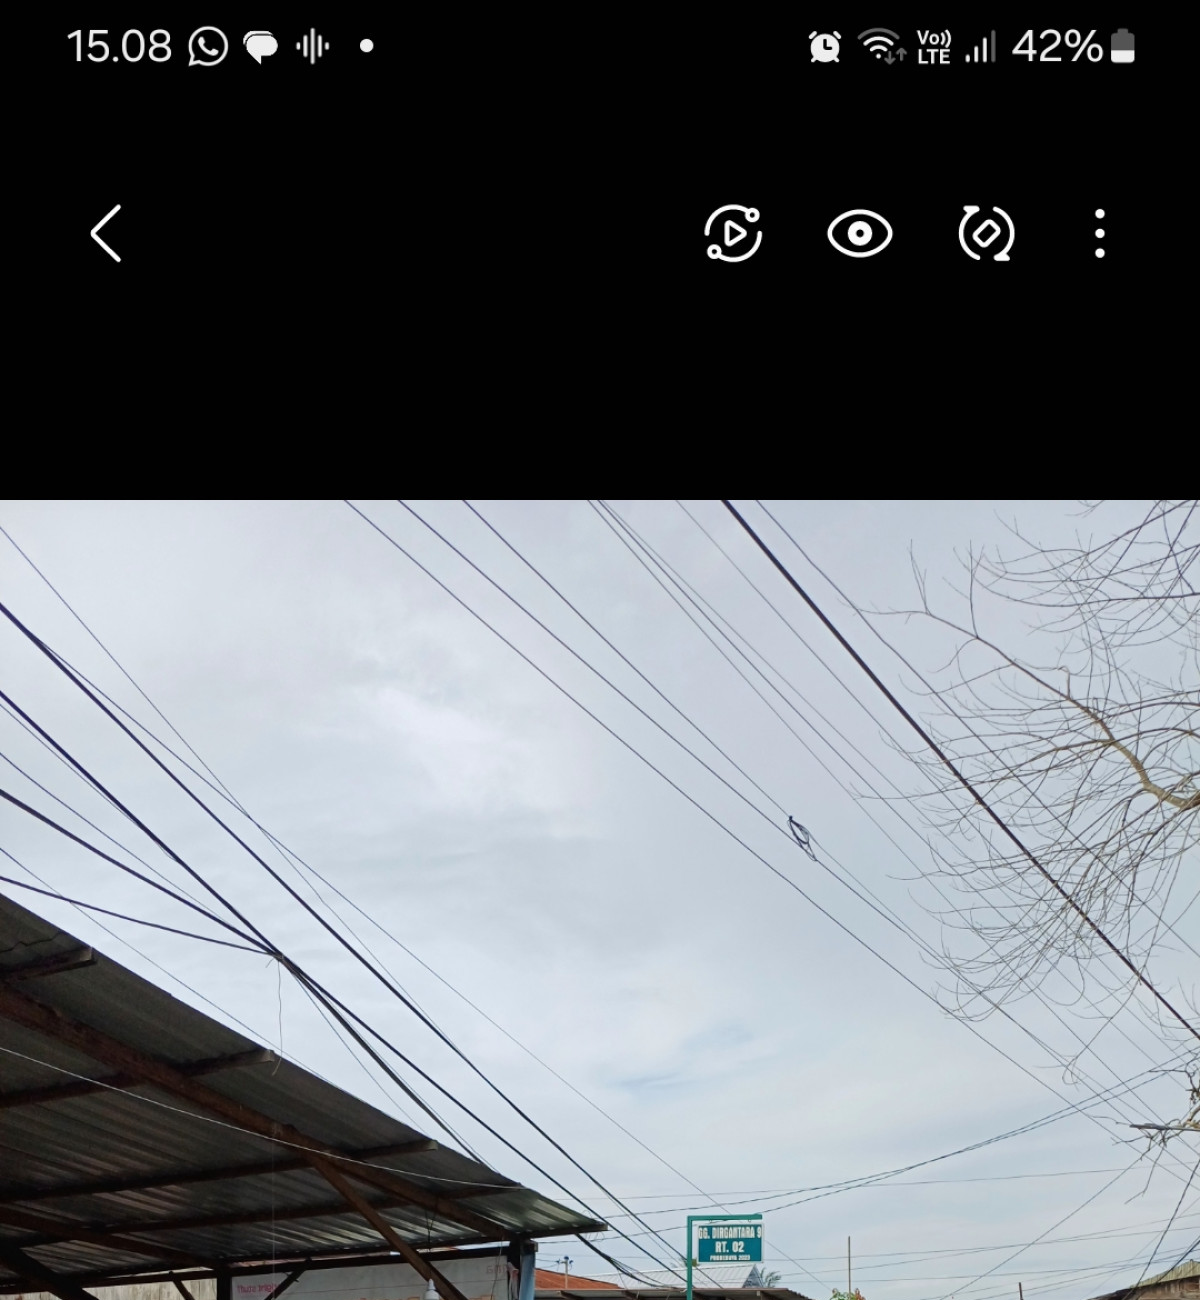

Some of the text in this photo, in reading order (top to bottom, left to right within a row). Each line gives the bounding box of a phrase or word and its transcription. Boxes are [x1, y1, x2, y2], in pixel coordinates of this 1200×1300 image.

[711, 1226, 755, 1239] DIRGANTARA
[715, 1241, 745, 1253] RT. 02
